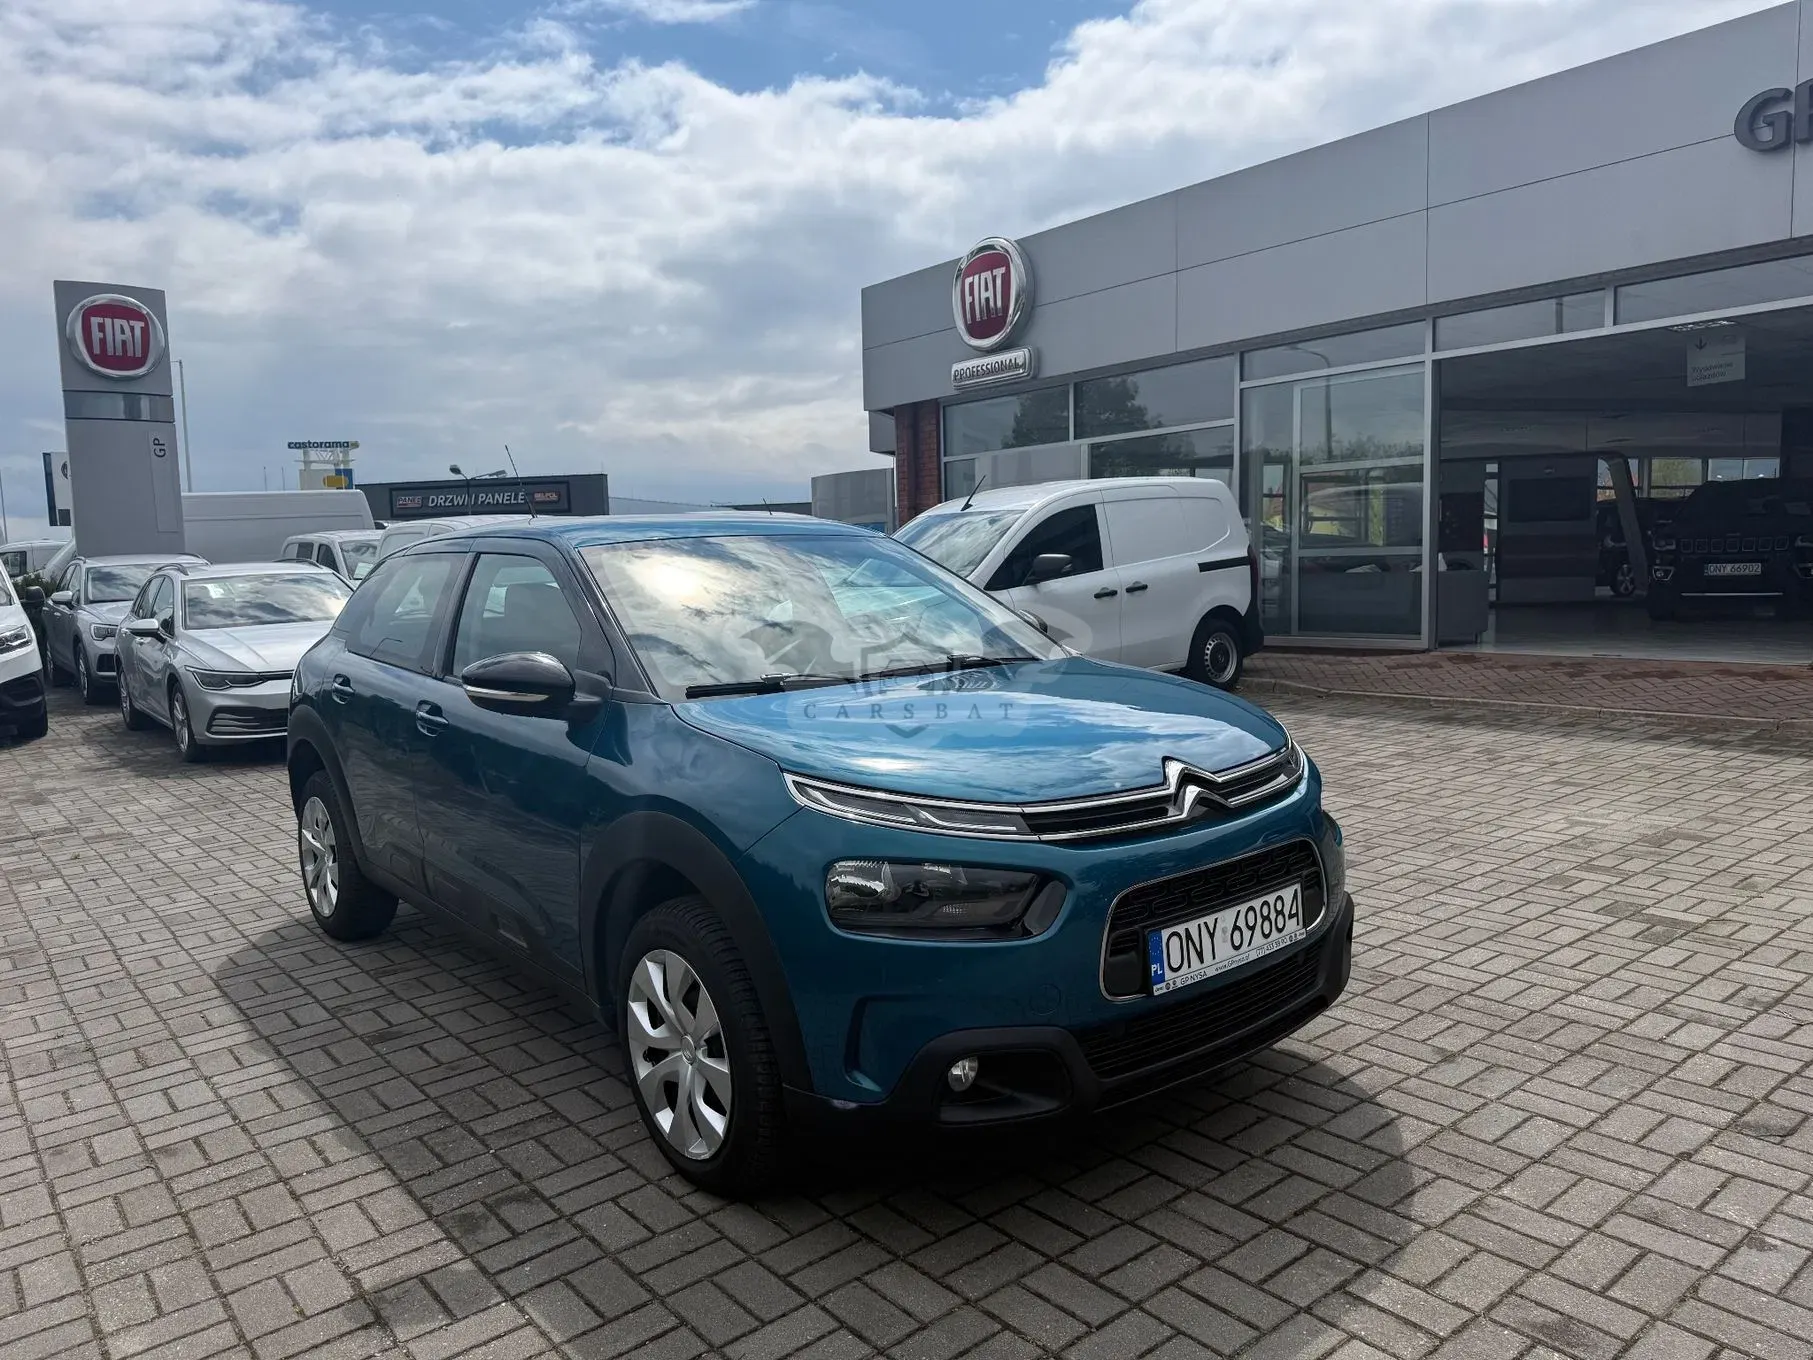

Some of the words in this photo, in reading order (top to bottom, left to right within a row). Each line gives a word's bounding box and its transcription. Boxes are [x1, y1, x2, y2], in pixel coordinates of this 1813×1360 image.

[965, 266, 1006, 324] FIAT
[90, 316, 144, 357] FIAT
[953, 357, 1019, 381] PROFESSIONAL
[153, 437, 167, 458] GP
[288, 440, 349, 449] castorama
[428, 493, 468, 507] DRZWI
[478, 492, 525, 505] PANELE
[1165, 917, 1218, 973] ONY
[1230, 887, 1300, 951] 69884
[1151, 963, 1163, 976] PL
